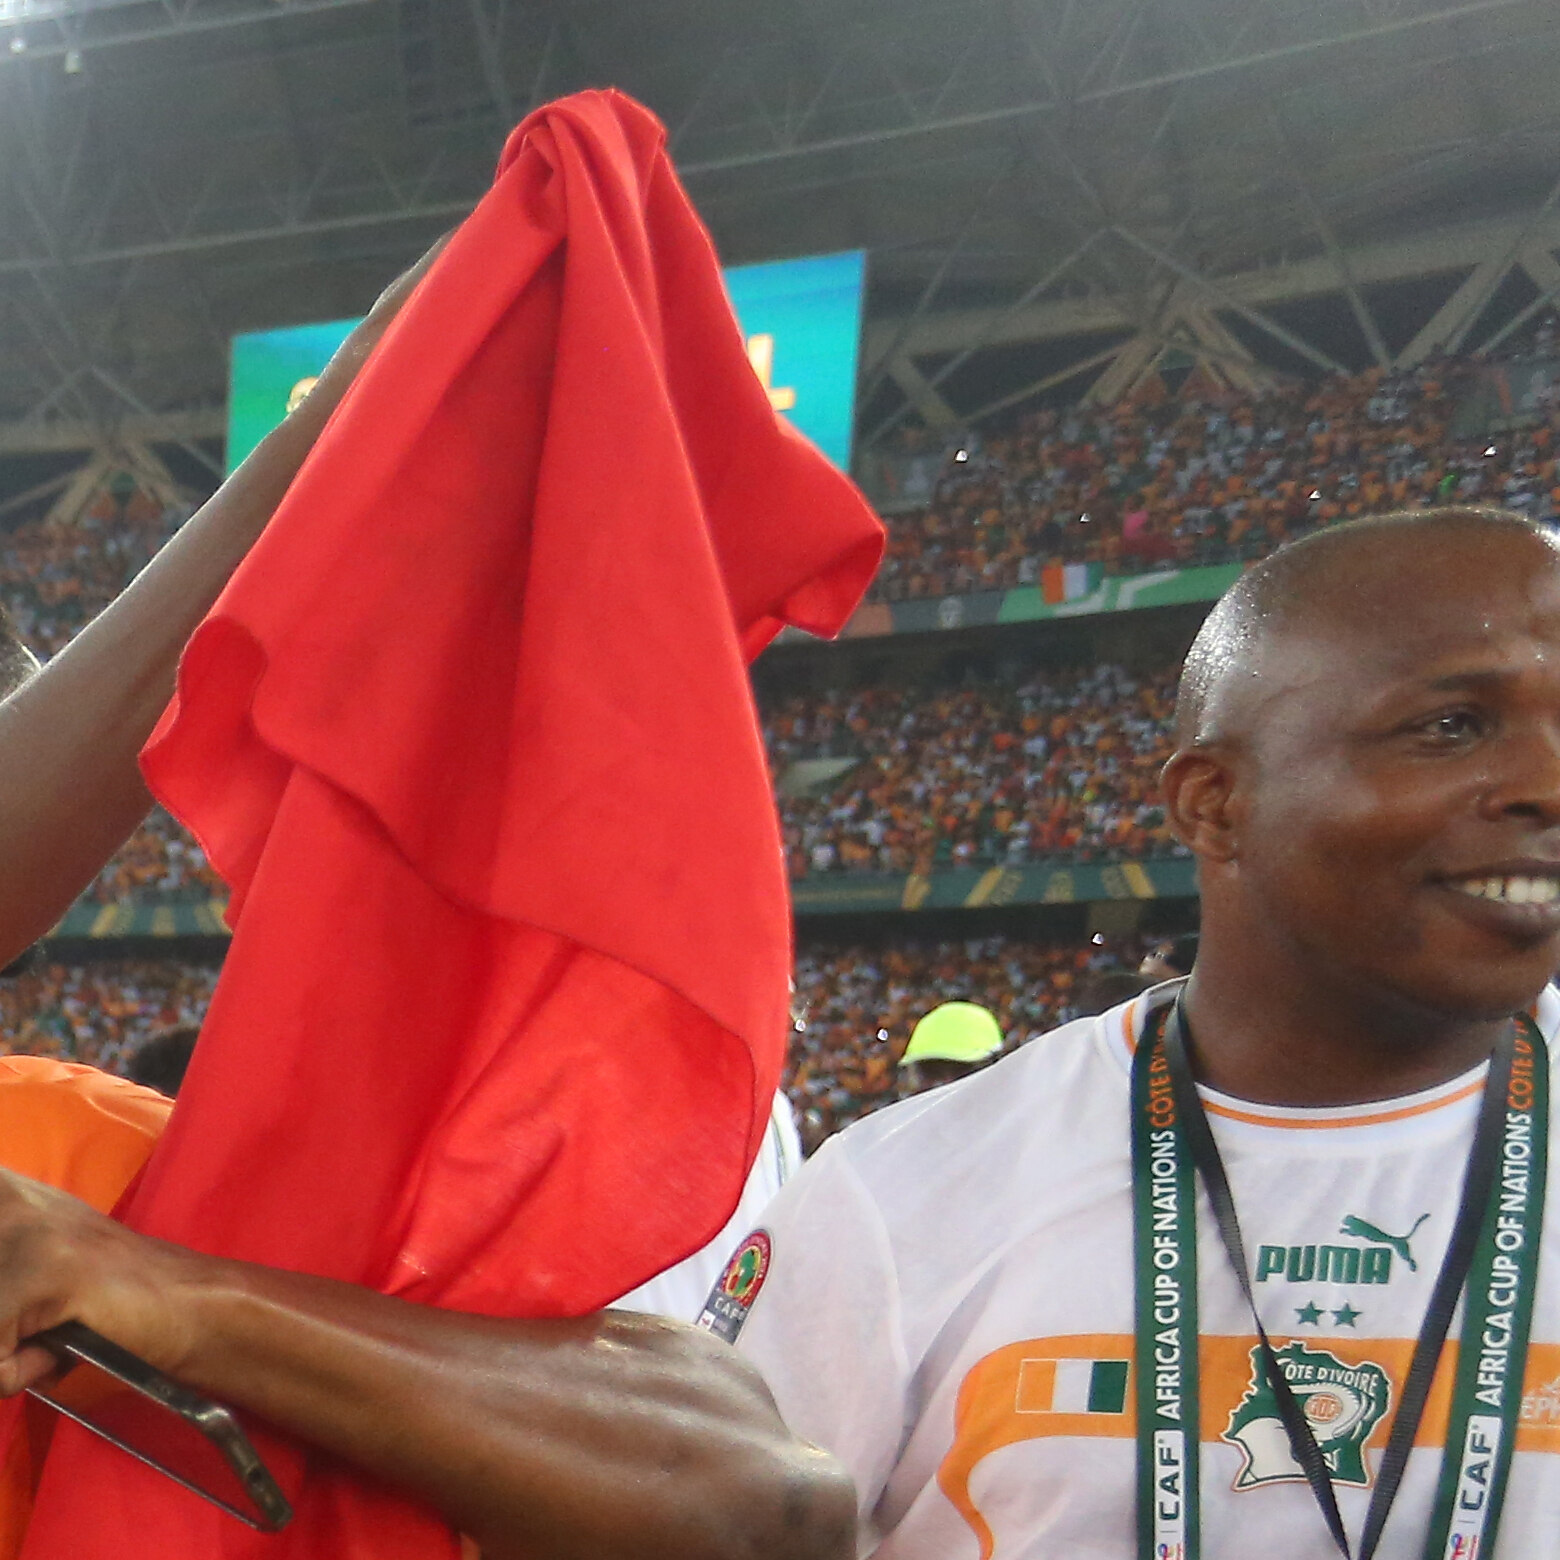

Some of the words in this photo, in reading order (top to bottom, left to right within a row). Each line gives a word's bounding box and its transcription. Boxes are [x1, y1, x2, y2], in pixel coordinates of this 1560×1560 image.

[1150, 1132, 1178, 1231] NATIONS
[1499, 1112, 1532, 1213] NATIONS
[1153, 1236, 1179, 1270] OF
[1494, 1216, 1525, 1251] OF
[1255, 1245, 1392, 1284] PUMA
[1488, 1255, 1520, 1307] CUP
[1154, 1274, 1180, 1325] CUP
[1155, 1327, 1181, 1420] AFRICA
[1475, 1311, 1514, 1407] AFRICA
